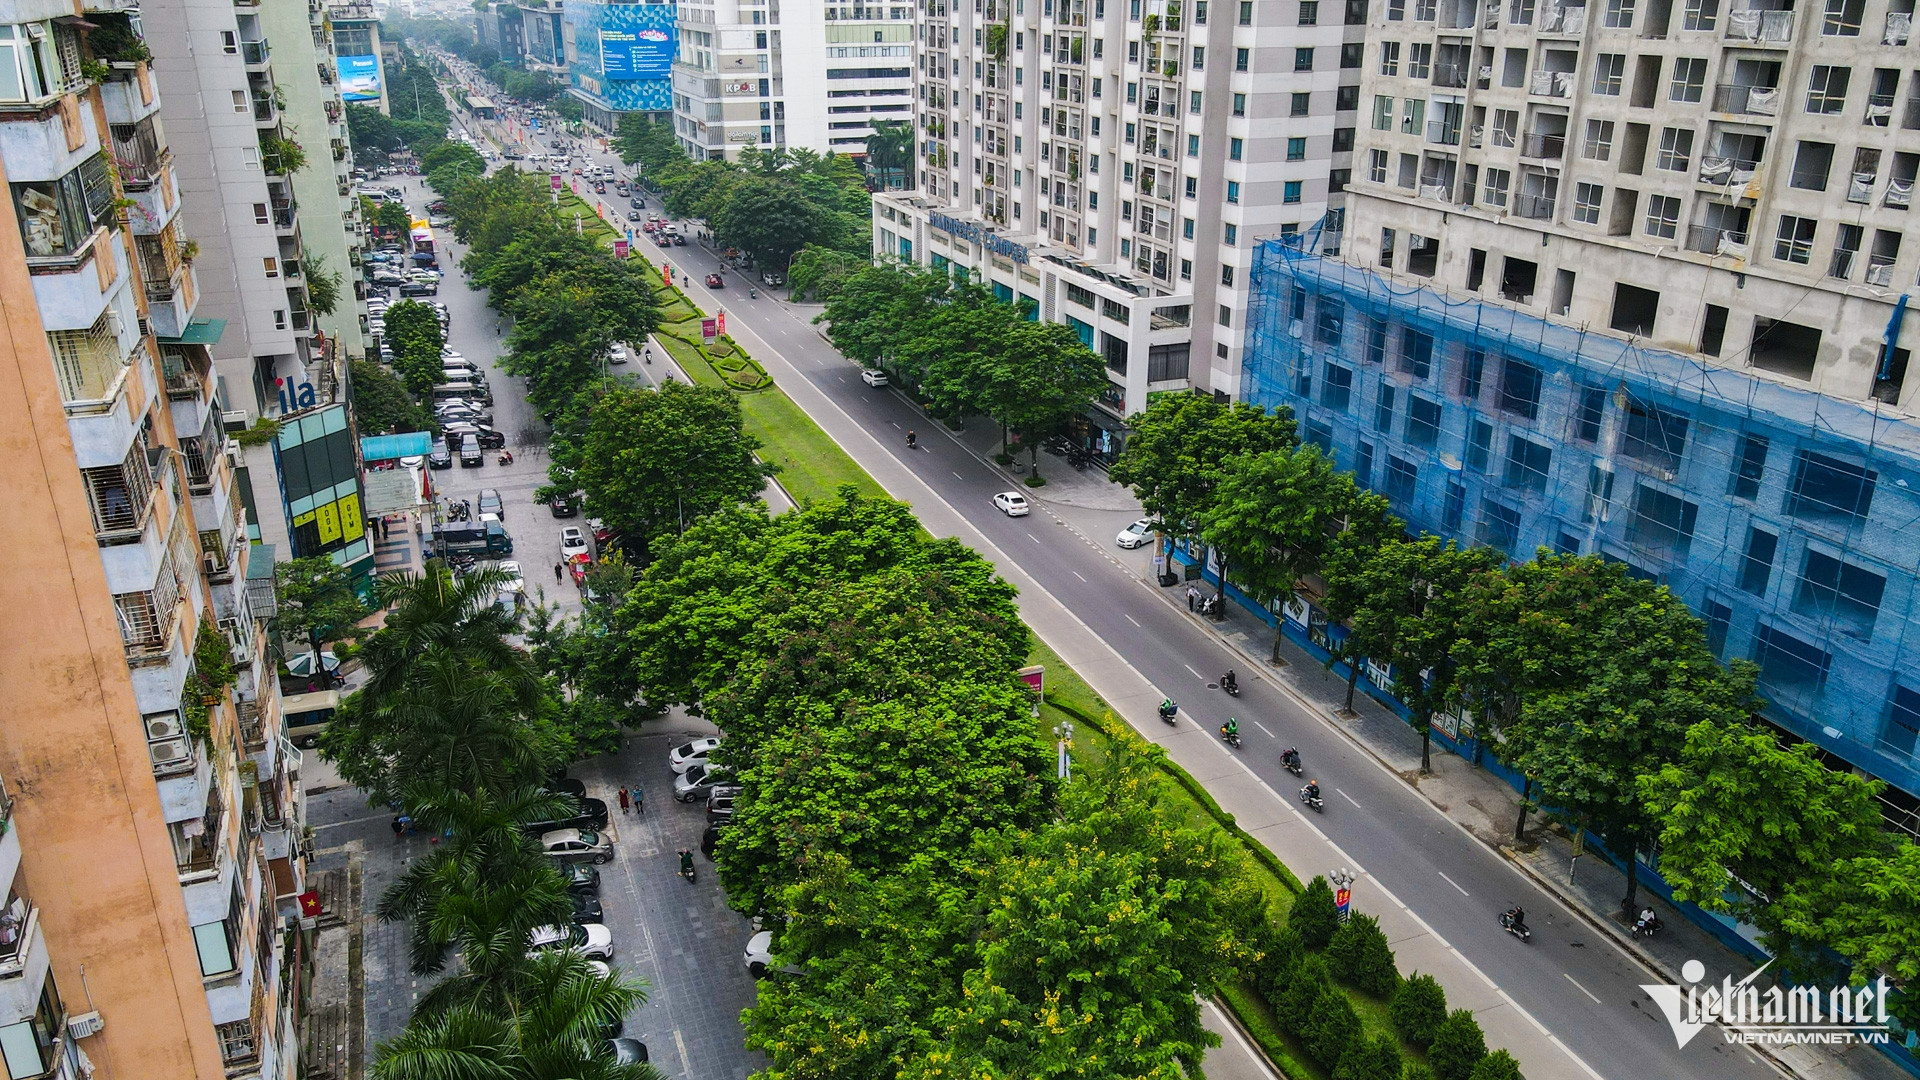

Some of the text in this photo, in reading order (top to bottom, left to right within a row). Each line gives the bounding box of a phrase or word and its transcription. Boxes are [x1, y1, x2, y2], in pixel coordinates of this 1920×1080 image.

[983, 231, 1029, 265] COMPLEX
[275, 376, 316, 414] ila
[324, 505, 333, 534] OGA
[346, 504, 355, 528] GYM
